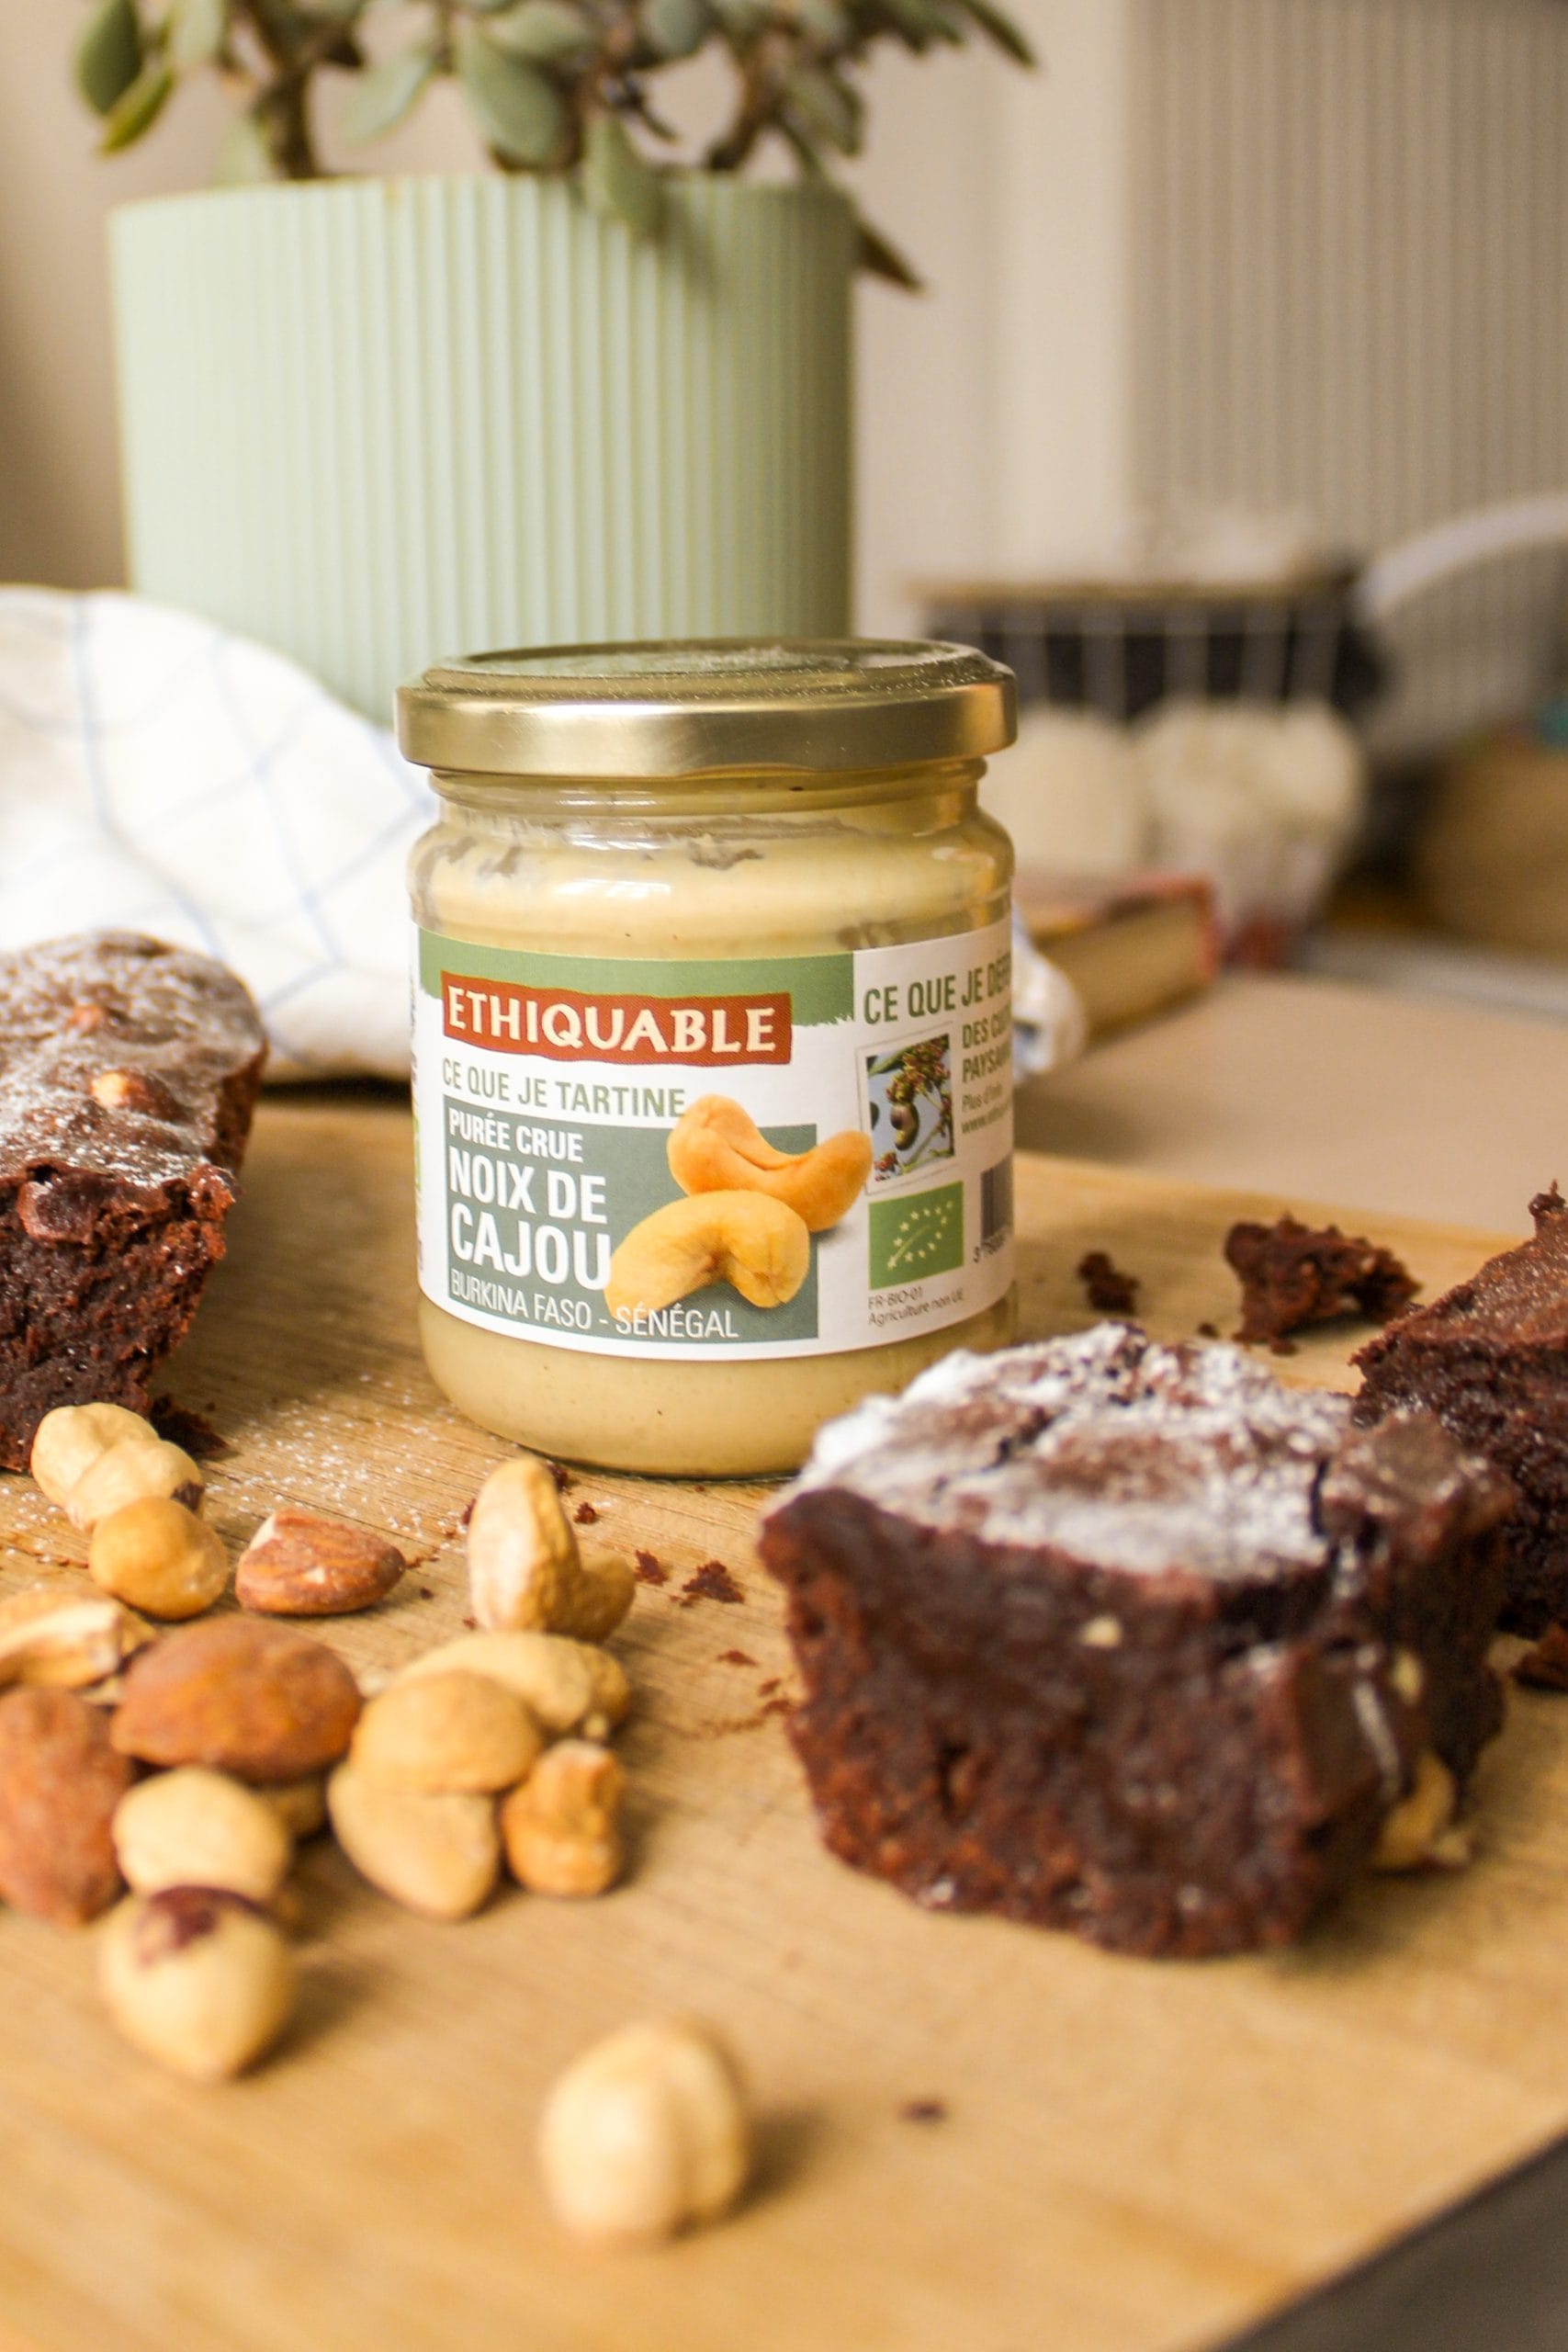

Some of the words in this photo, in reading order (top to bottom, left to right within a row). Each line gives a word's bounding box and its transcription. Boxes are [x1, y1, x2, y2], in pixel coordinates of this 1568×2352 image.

[447, 984, 776, 1054] ETHIQUABLE
[864, 985, 898, 1024] CE
[908, 975, 955, 1017] QUE
[961, 967, 983, 1006] JE
[962, 1017, 988, 1049] DES
[443, 1057, 463, 1089] CE
[467, 1066, 510, 1101] QUE
[518, 1077, 547, 1108] JE
[555, 1080, 685, 1118] TARTINE
[448, 1106, 511, 1148] PURÉE
[516, 1125, 583, 1164] CRUE
[448, 1145, 536, 1215] NOIX
[547, 1170, 608, 1226] DE
[451, 1202, 611, 1292] CAJOU
[450, 1269, 526, 1317] BURKINA
[533, 1294, 592, 1331] FASO
[615, 1299, 739, 1340] SÉNÉGAL
[868, 1303, 931, 1328] Agriculture
[931, 1295, 952, 1309] non
